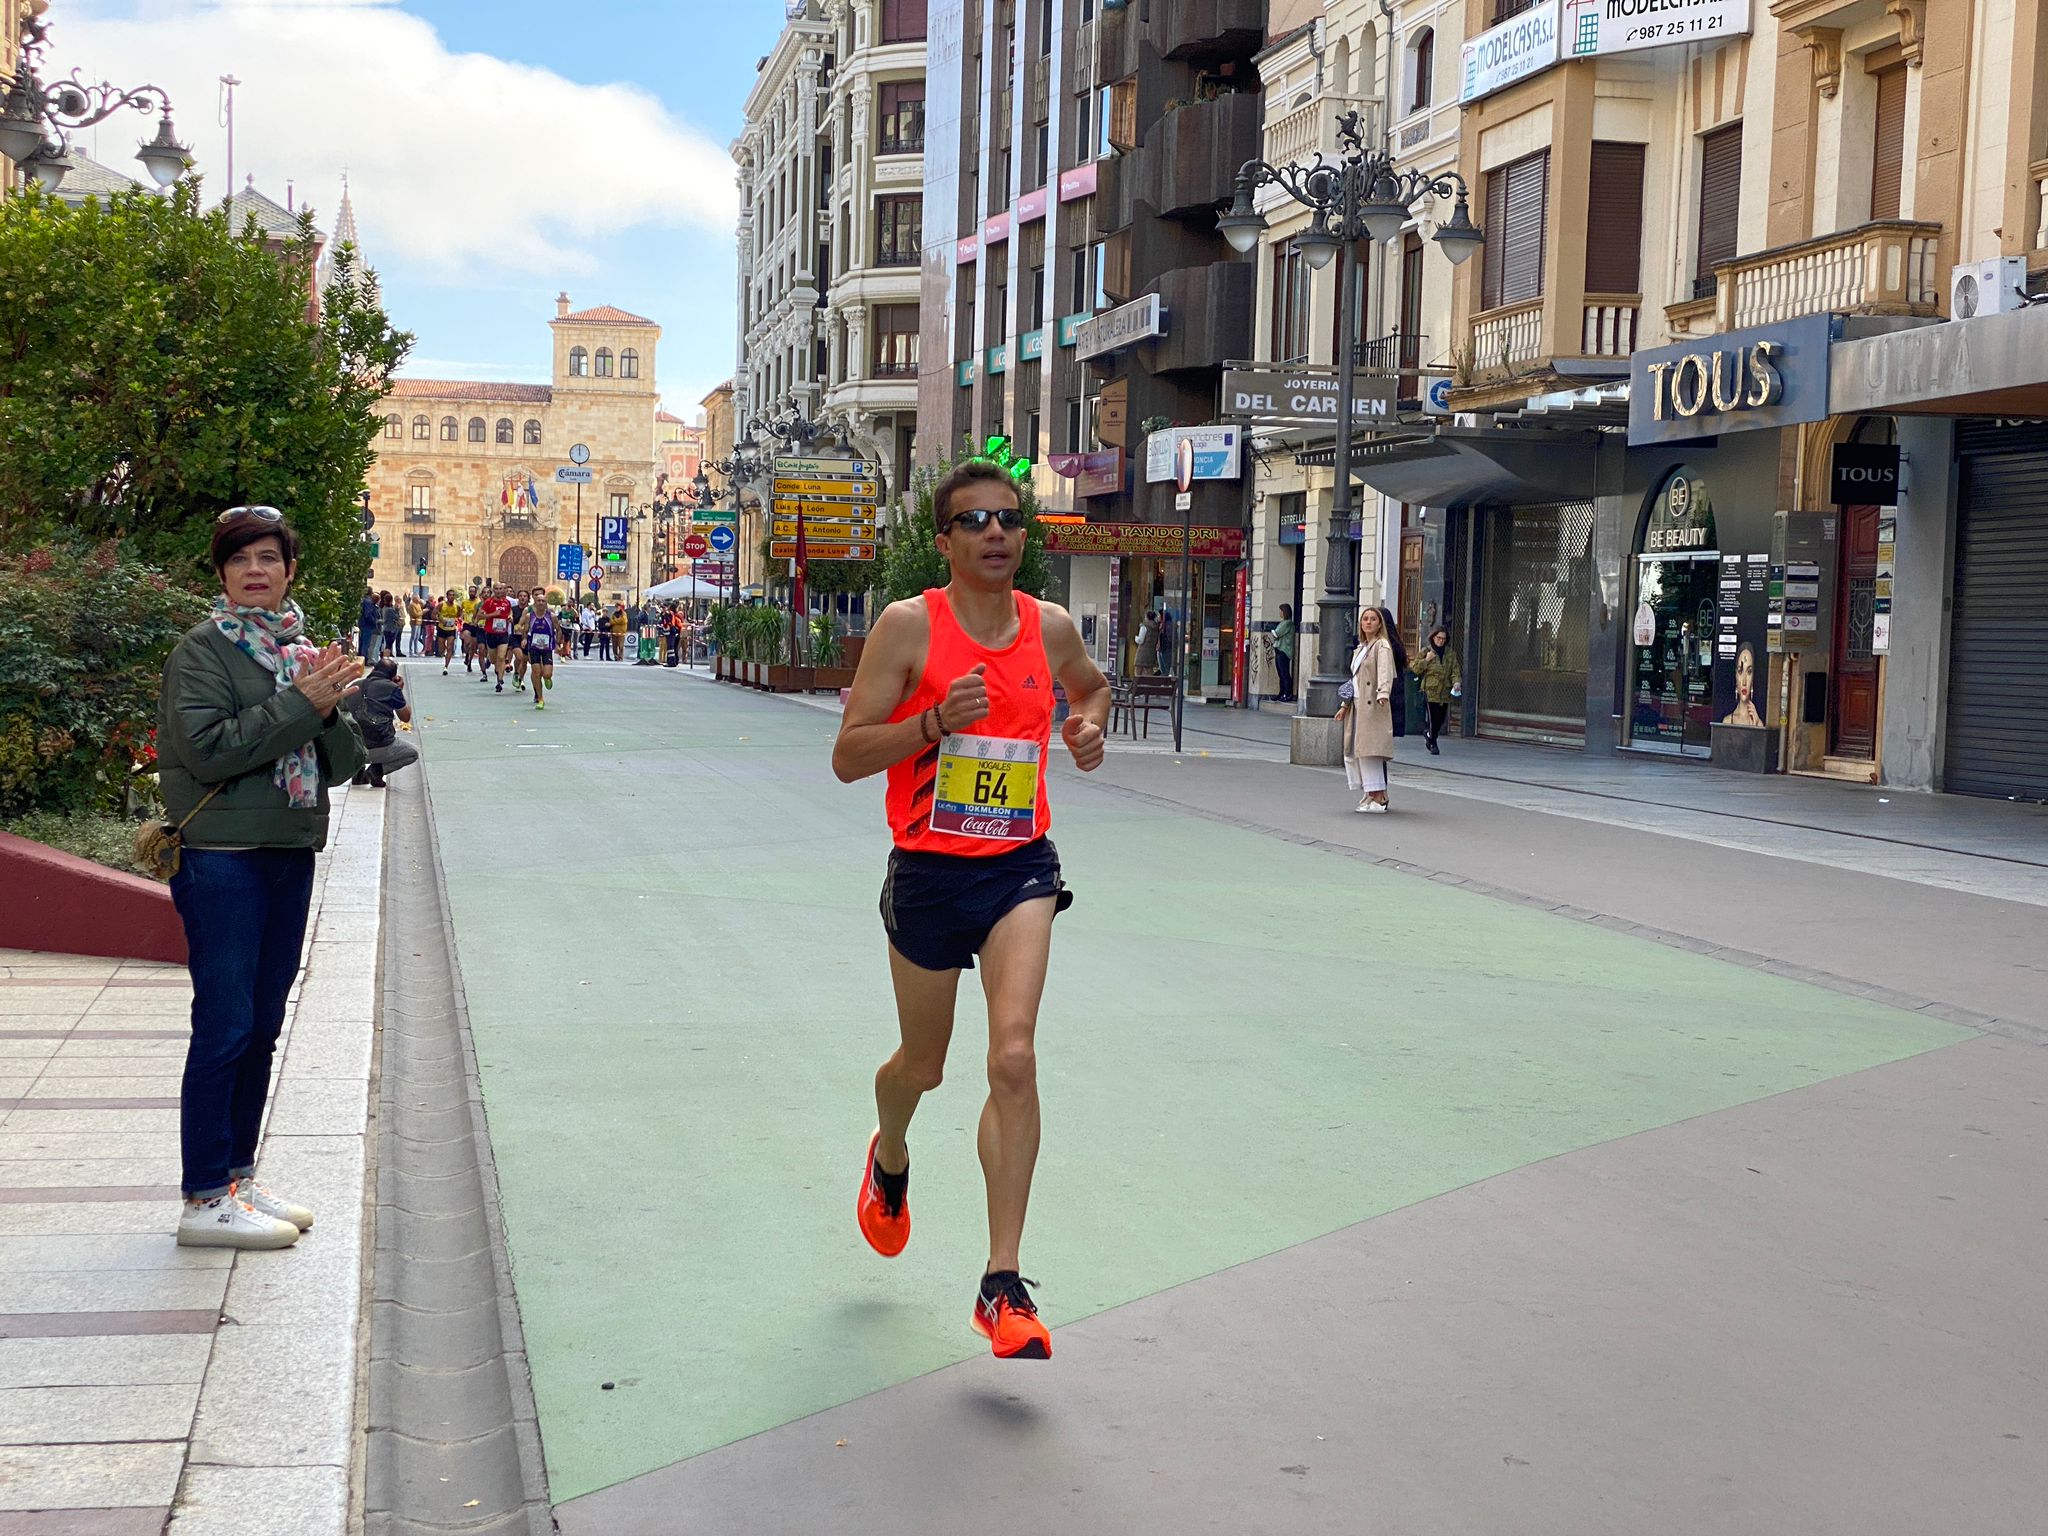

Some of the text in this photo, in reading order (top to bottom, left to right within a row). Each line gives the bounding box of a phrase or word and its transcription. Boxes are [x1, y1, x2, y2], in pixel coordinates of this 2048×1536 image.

[1639, 15, 1723, 40] 987 25 11 21
[1284, 378, 1340, 392] JOYERIA
[1647, 341, 1783, 421] TOUS
[1235, 392, 1387, 416] DEL CAREN
[1838, 466, 1895, 483] TOUS
[1671, 487, 1686, 506] BE
[775, 501, 791, 511] Luis
[1280, 513, 1306, 525] ESTRELLA
[604, 518, 618, 540] P
[812, 525, 841, 534] Antonio
[1049, 525, 1220, 540] ROYAL TANDOORI
[1650, 527, 1707, 548] BE BEAUTY
[685, 542, 705, 550] STOP
[1699, 609, 1713, 627] BE
[978, 761, 1012, 772] NOGALES
[973, 770, 1009, 806] 64
